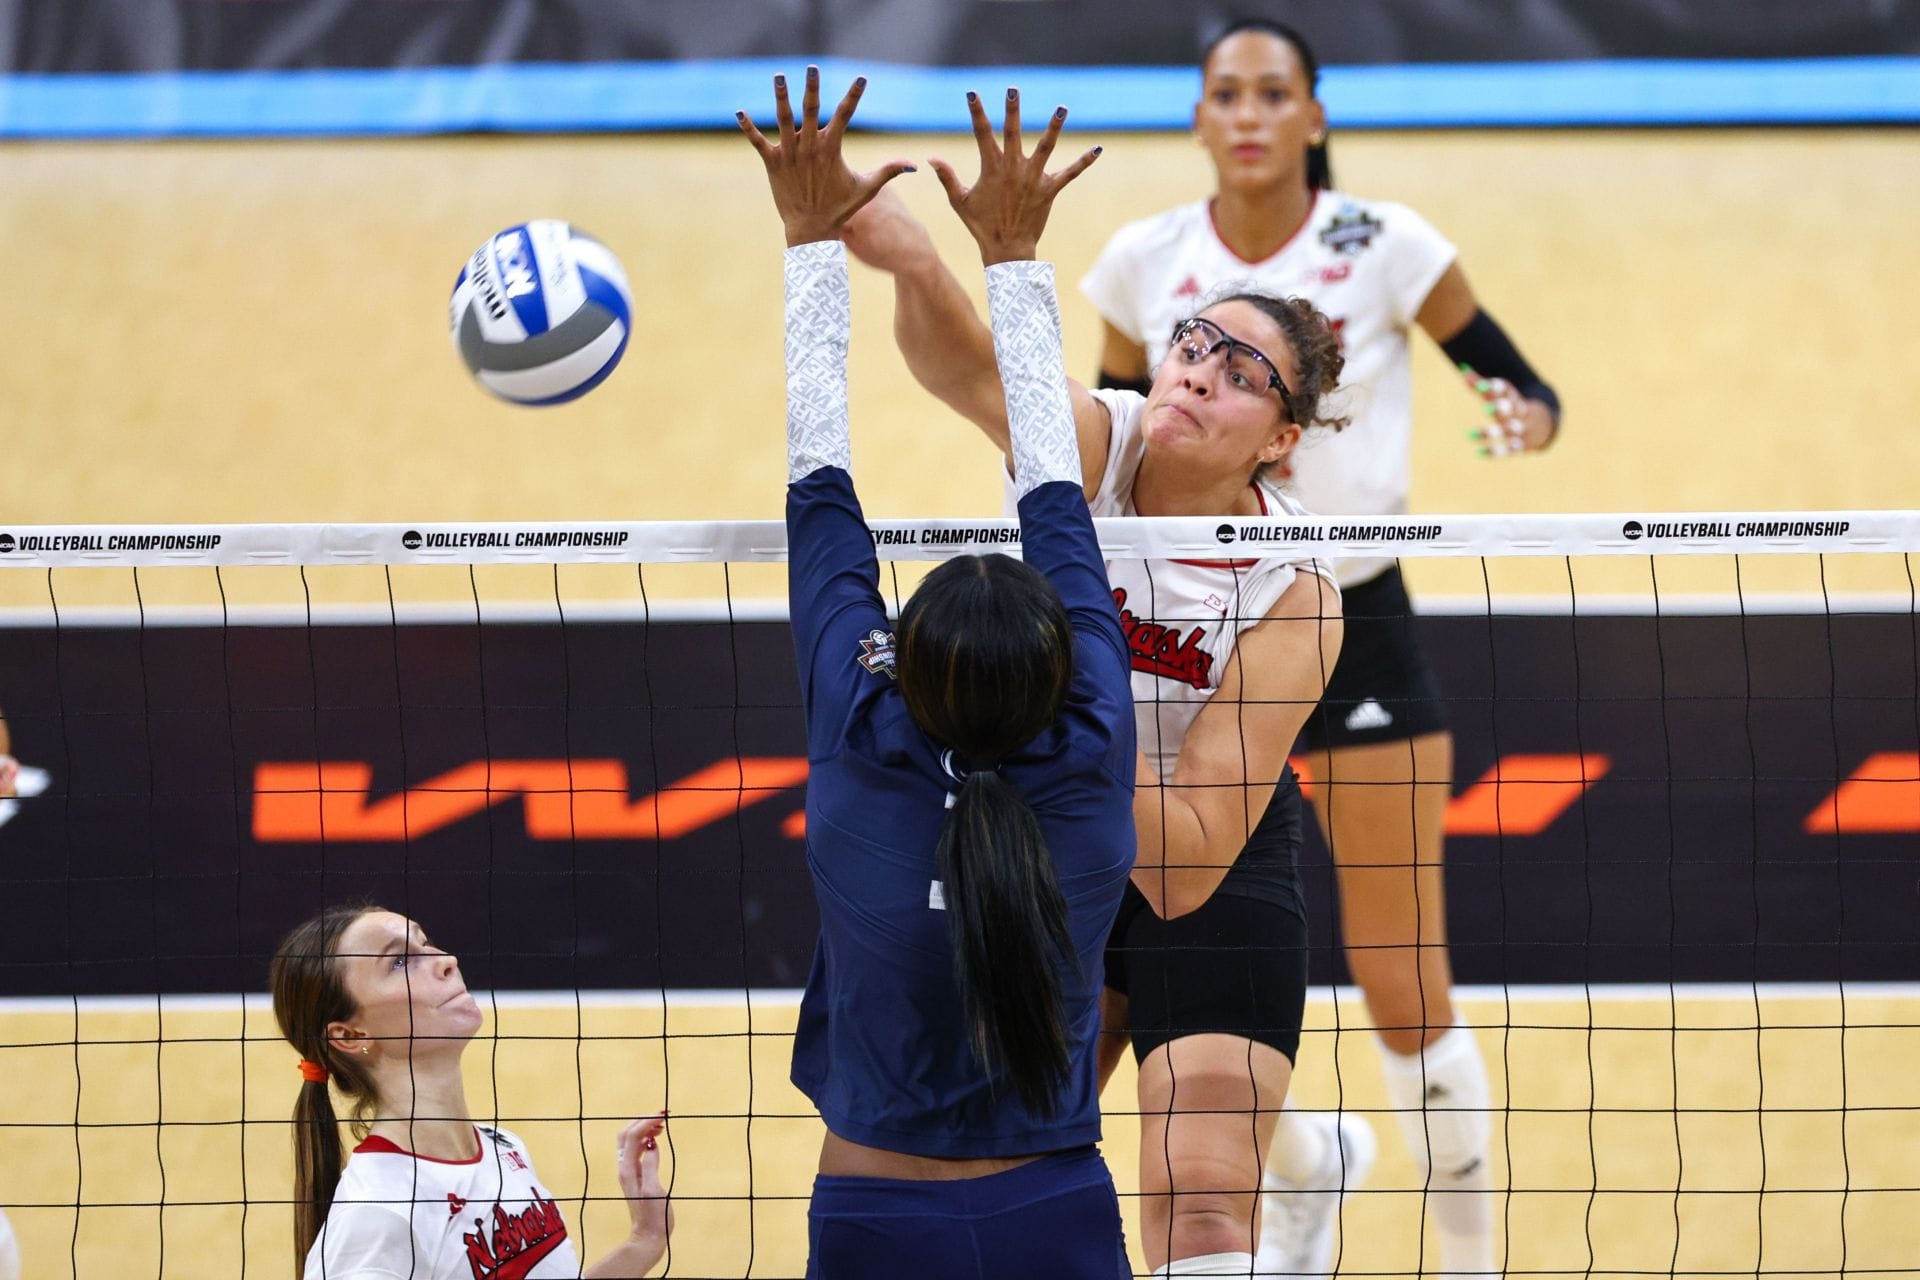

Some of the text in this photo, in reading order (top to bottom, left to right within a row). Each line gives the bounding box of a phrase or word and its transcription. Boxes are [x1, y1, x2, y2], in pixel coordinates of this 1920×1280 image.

[870, 528, 1022, 544] YBALL CHAMPIONSH
[1240, 526, 1324, 541] VOLLEYBALL
[1329, 525, 1442, 540] CHAMPIONSHIP
[1647, 523, 1731, 538] VOLLEYBALL
[1736, 521, 1849, 536] CHAMPIONSHIP
[19, 536, 103, 551] VOLLEYBALL
[108, 535, 221, 550] CHAMPIONSHIP
[426, 533, 510, 547] VOLLEYBALL
[515, 531, 628, 546] CHAMPIONSHIP
